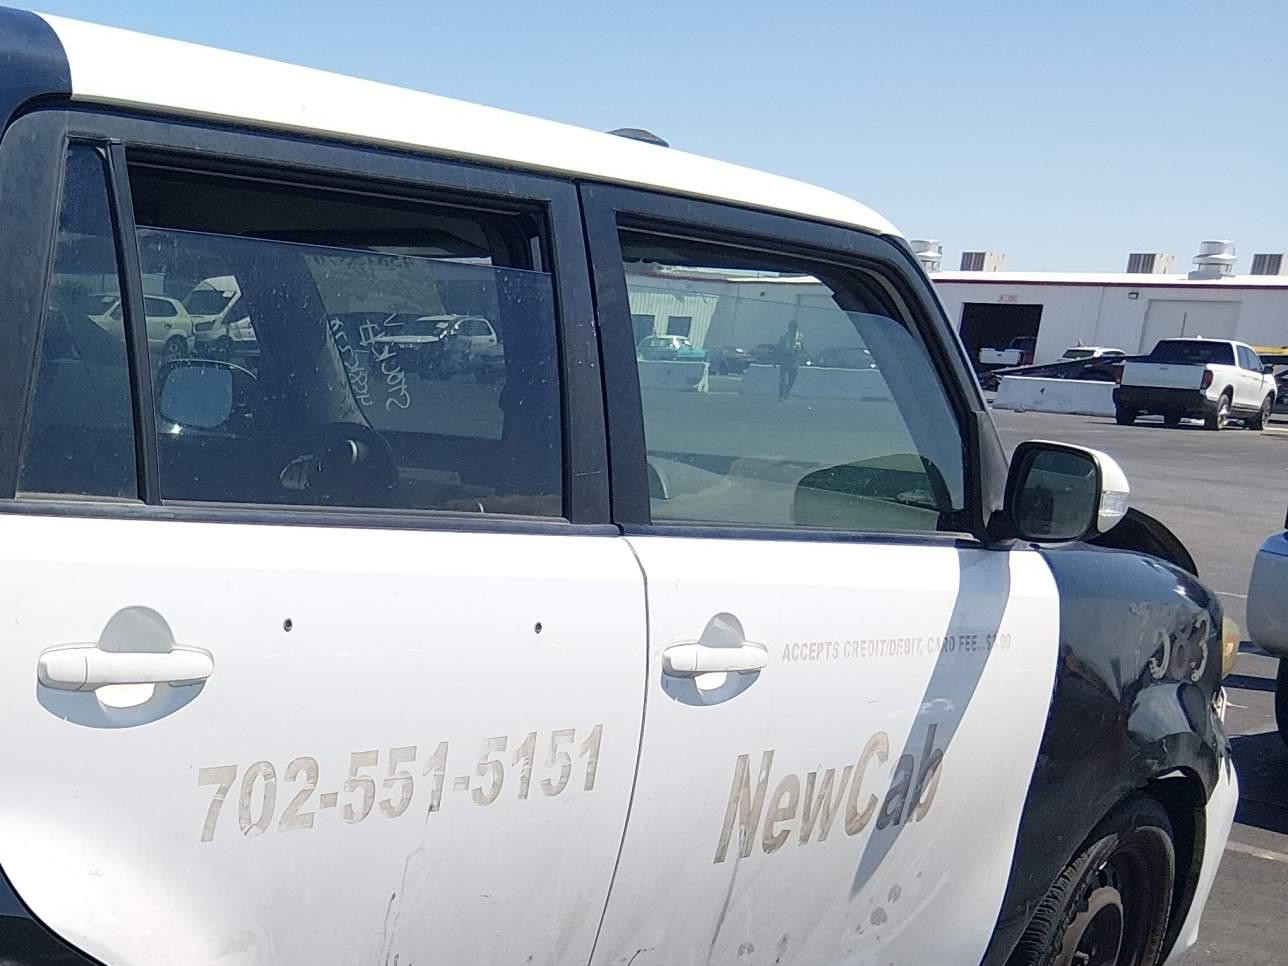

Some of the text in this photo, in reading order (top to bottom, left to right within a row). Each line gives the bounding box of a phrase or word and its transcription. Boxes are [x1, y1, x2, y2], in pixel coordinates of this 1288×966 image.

[782, 641, 839, 663] ACCEPTS
[927, 635, 956, 654] CARD
[198, 723, 604, 843] 702-551-5151
[713, 723, 944, 864] NewCab
